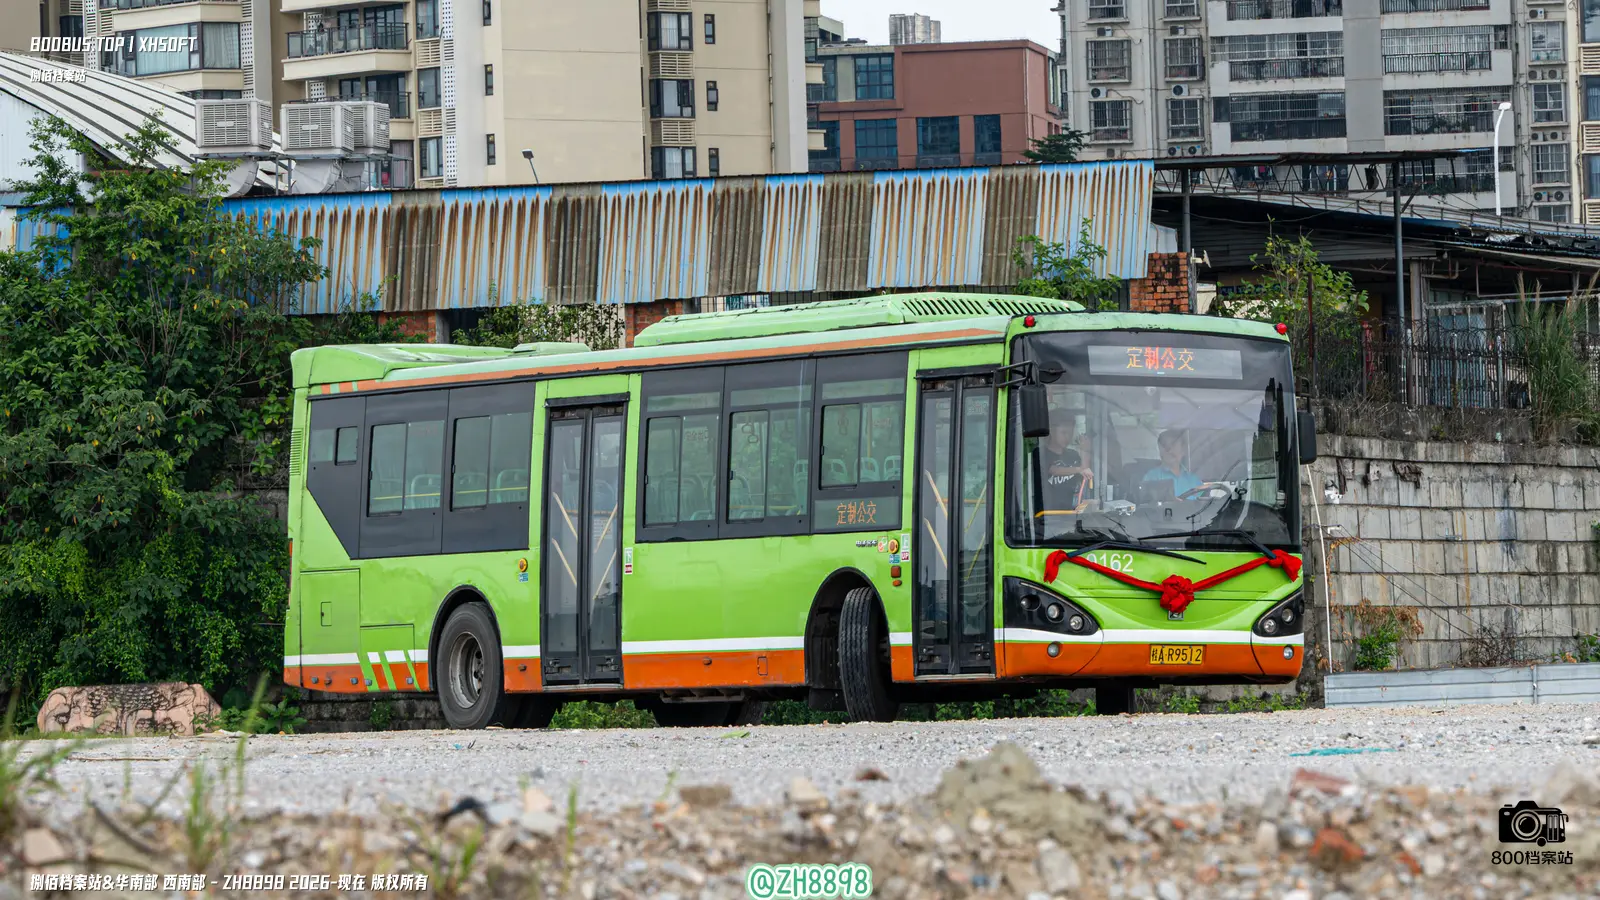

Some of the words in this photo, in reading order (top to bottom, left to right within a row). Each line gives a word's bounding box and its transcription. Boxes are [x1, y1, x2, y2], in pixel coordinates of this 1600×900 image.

[1126, 346, 1195, 371] 定制公交
[836, 501, 877, 525] 定制公交
[1087, 552, 1134, 572] 9162
